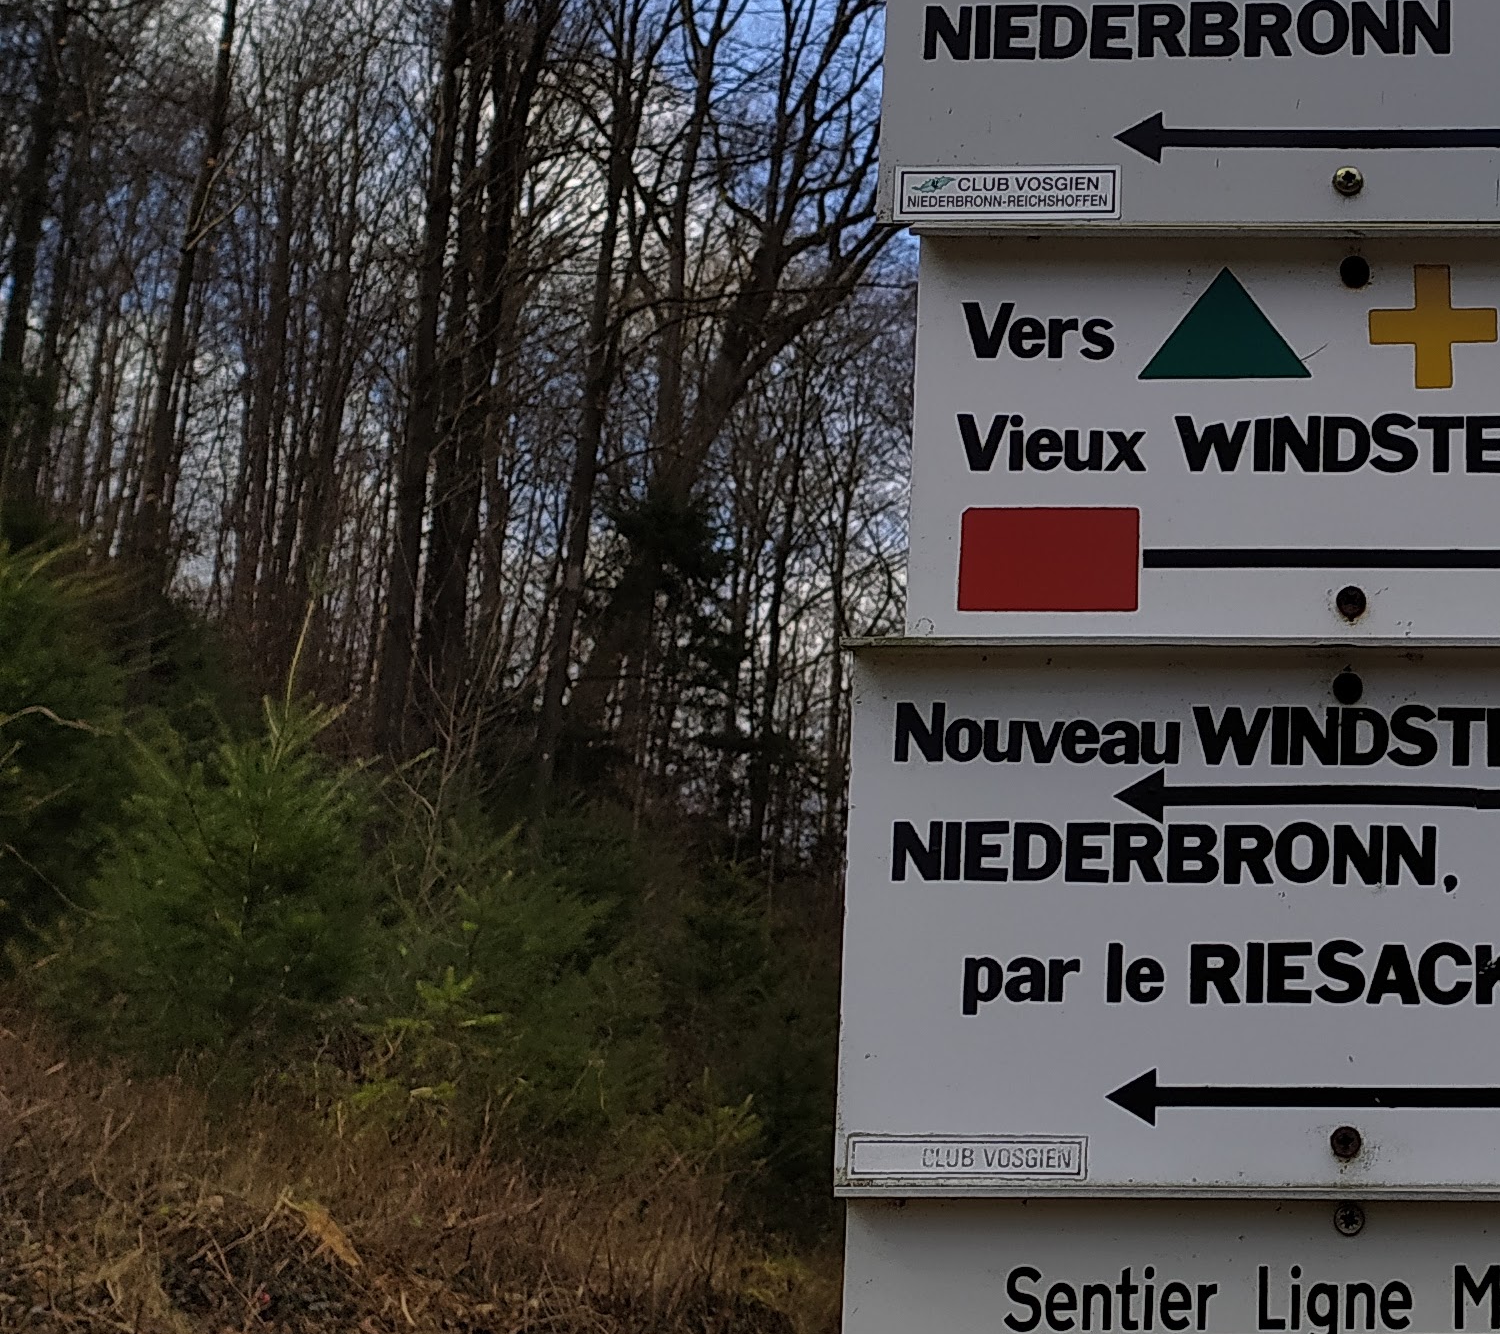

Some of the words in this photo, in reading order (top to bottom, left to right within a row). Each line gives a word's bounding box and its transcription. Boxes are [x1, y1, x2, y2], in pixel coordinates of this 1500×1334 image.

[906, 193, 1109, 208] NIEDERBRONN-REICHSHOFFEN
[956, 177, 1011, 190] CLUB
[1015, 176, 1100, 190] VOSGIEN
[962, 301, 1116, 361] Vers
[956, 413, 1147, 473] Vieux
[894, 702, 1181, 766] Nouveau
[891, 821, 1458, 894] NIEDERBRONN,
[962, 952, 1081, 1015] par
[1105, 943, 1165, 1004] le
[922, 1147, 976, 1168] CLUB
[983, 1147, 1072, 1169] VOSGIEN
[1003, 1265, 1219, 1333] Sentier
